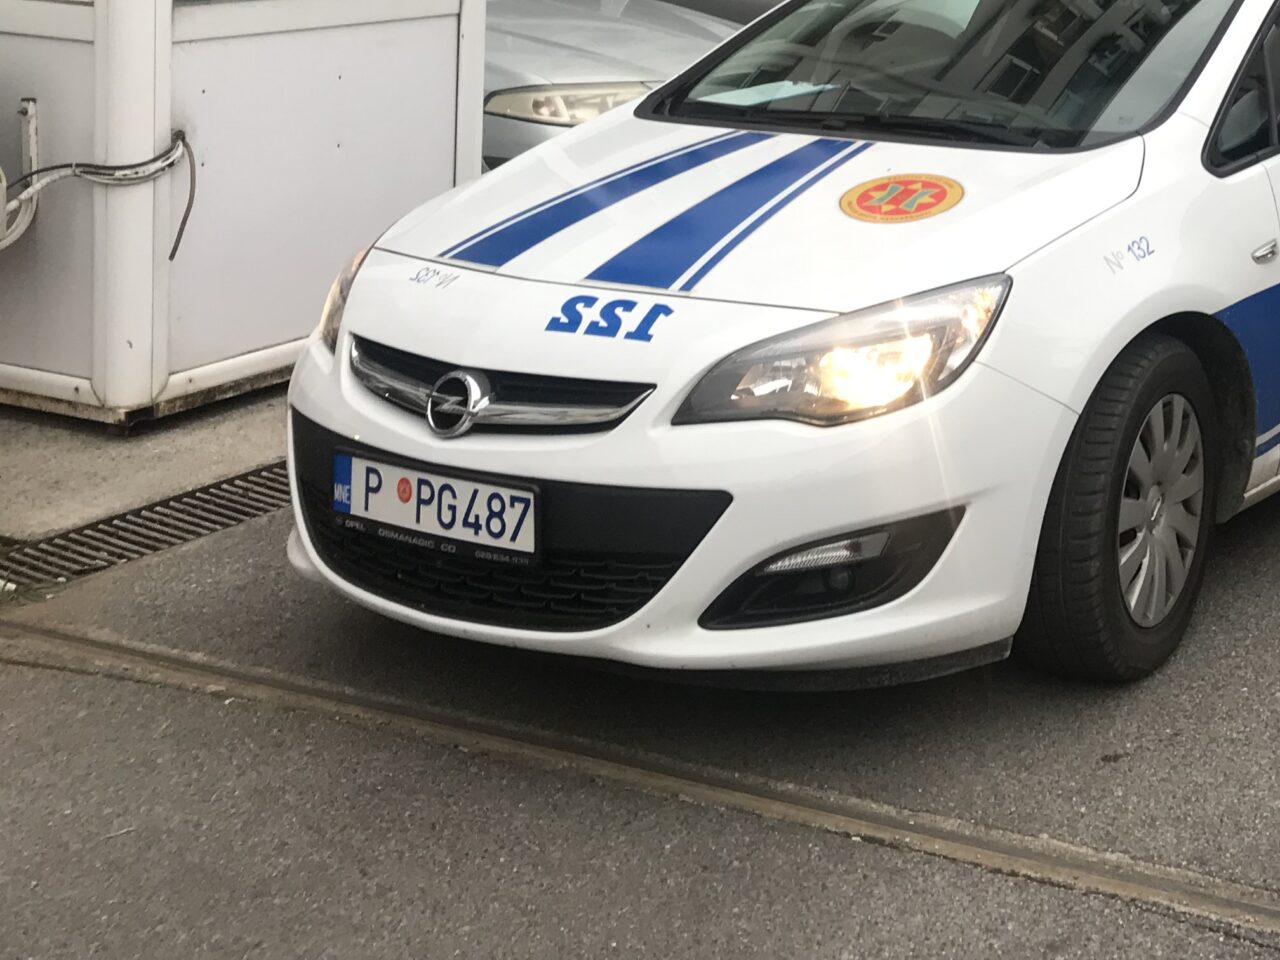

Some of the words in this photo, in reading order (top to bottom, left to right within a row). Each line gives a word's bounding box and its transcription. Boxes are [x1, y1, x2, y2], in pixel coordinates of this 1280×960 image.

[1127, 236, 1155, 263] 132
[334, 482, 351, 504] MNE
[363, 466, 383, 512] P
[415, 477, 532, 543] PG487
[345, 519, 366, 532] OPEL
